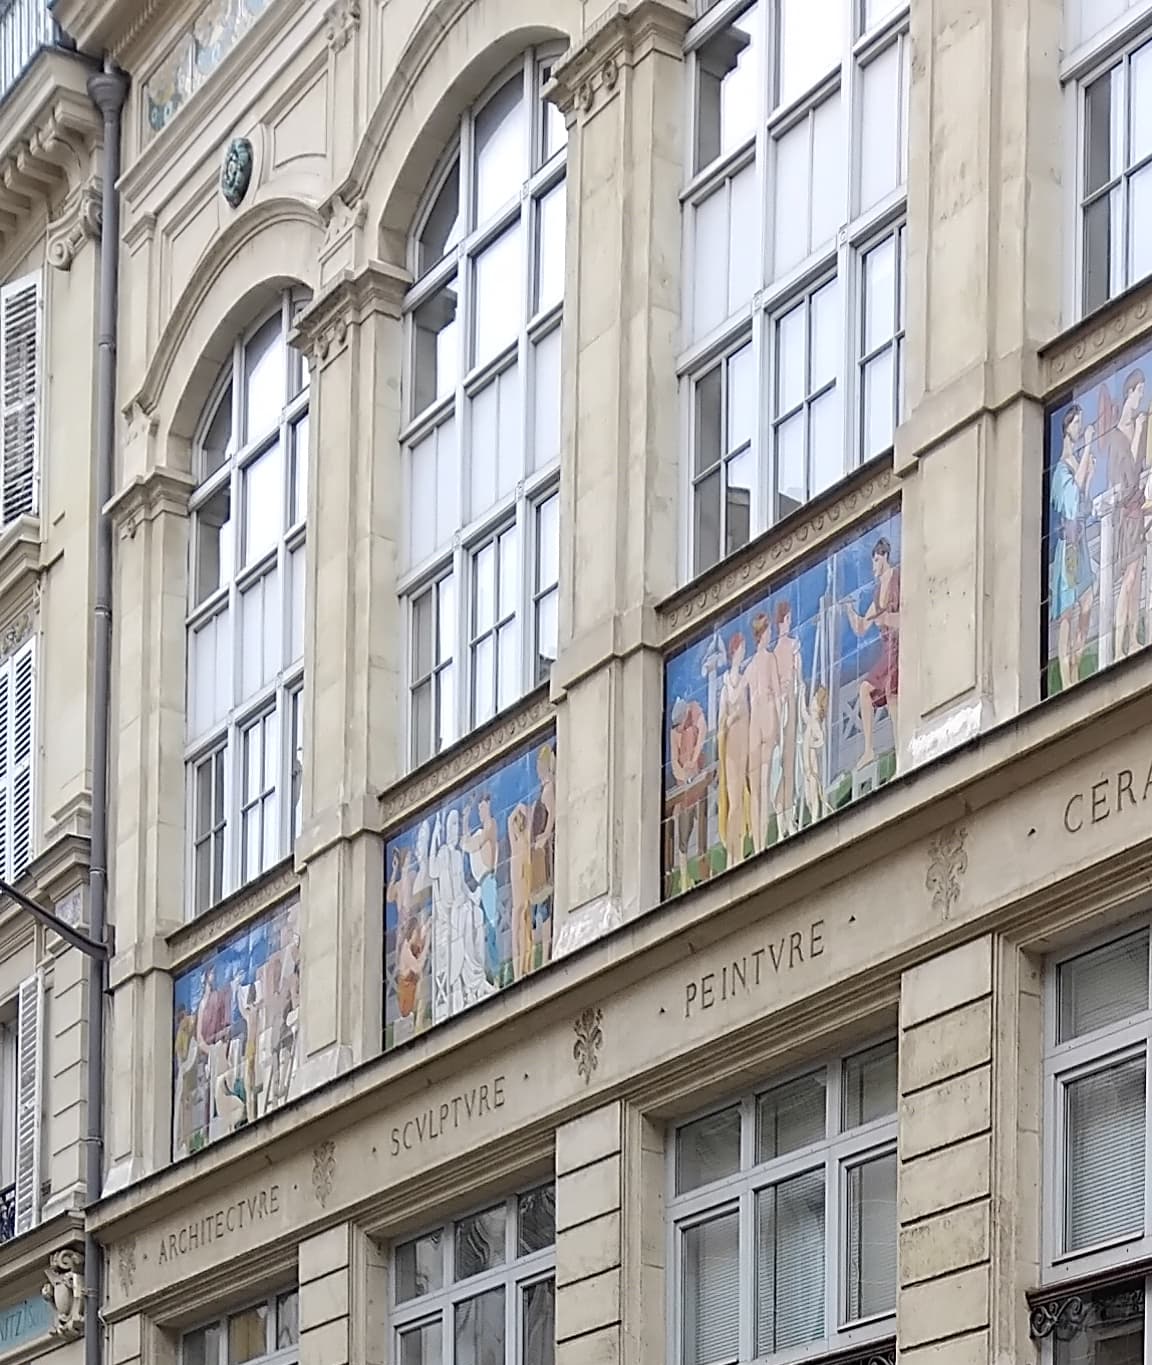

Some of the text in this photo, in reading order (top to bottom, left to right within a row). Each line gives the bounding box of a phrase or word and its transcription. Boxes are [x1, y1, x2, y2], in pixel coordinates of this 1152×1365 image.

[684, 919, 825, 1019] PEINTVRE
[390, 1076, 506, 1157] SCVLPTVRE
[158, 1185, 280, 1265] ARCHITECTVRE
